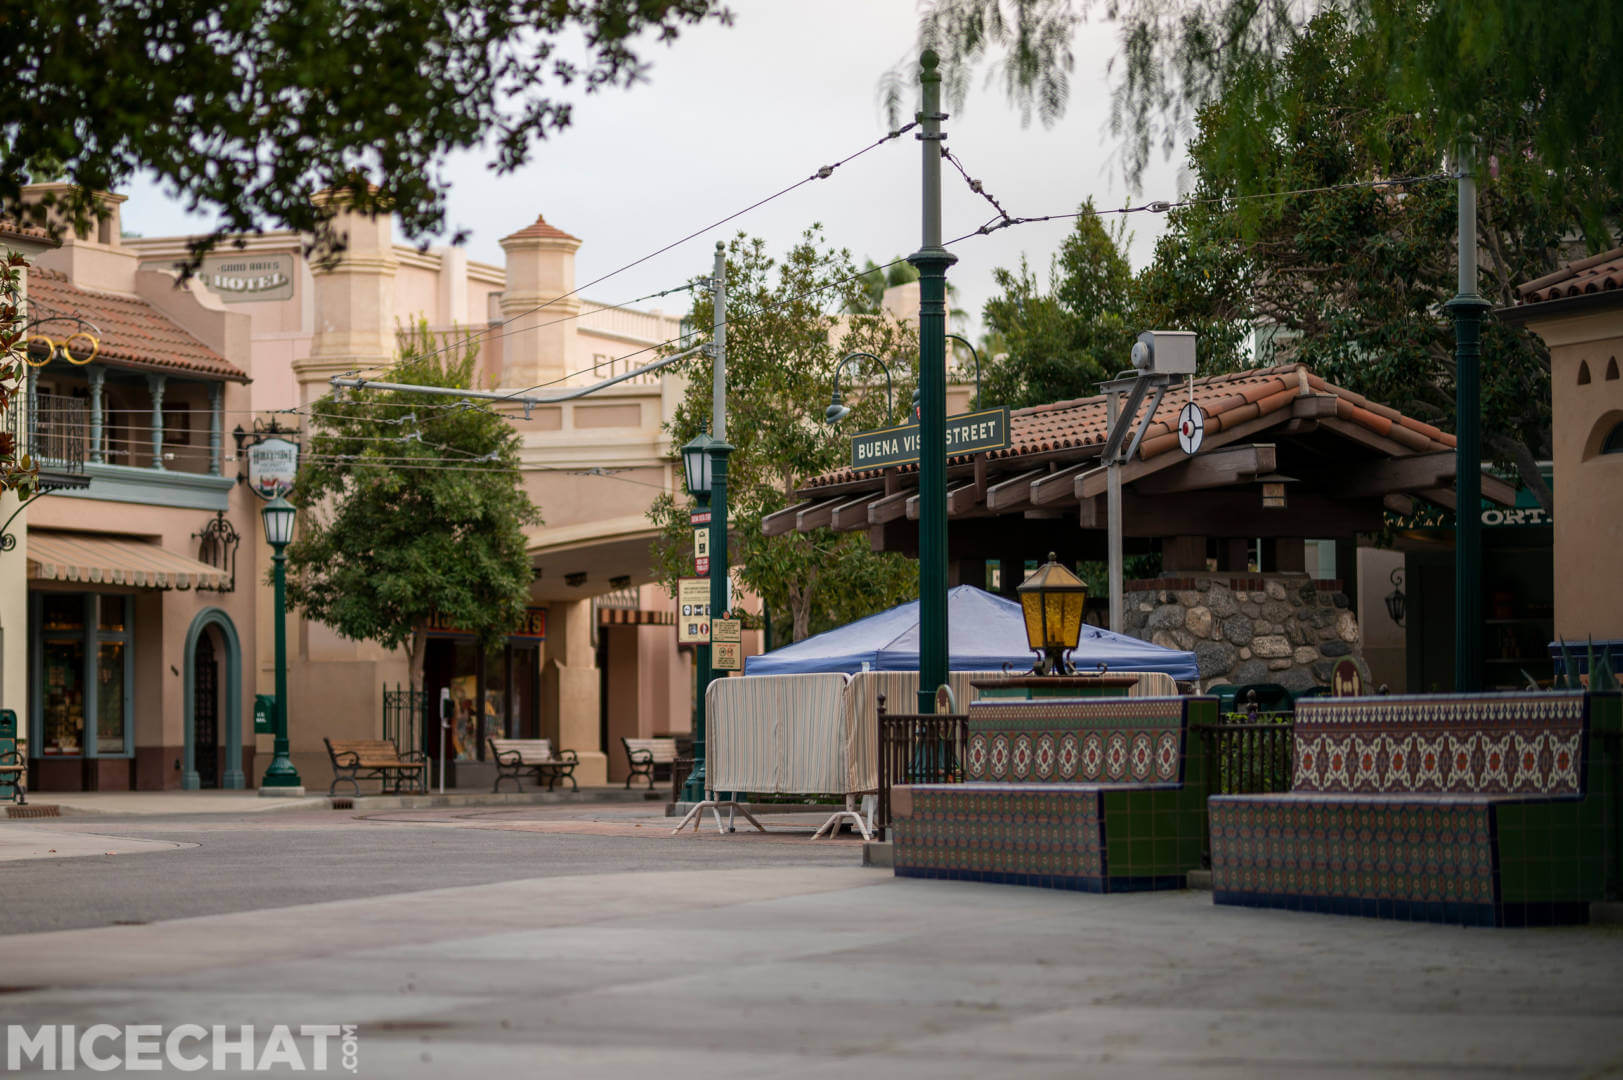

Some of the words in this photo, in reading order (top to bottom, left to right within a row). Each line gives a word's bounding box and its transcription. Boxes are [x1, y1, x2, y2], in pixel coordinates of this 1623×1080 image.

[214, 272, 289, 293] HOTEL
[858, 439, 899, 460] BUENA
[903, 434, 921, 452] VIS
[946, 421, 996, 445] STREET
[1481, 508, 1553, 526] ORT
